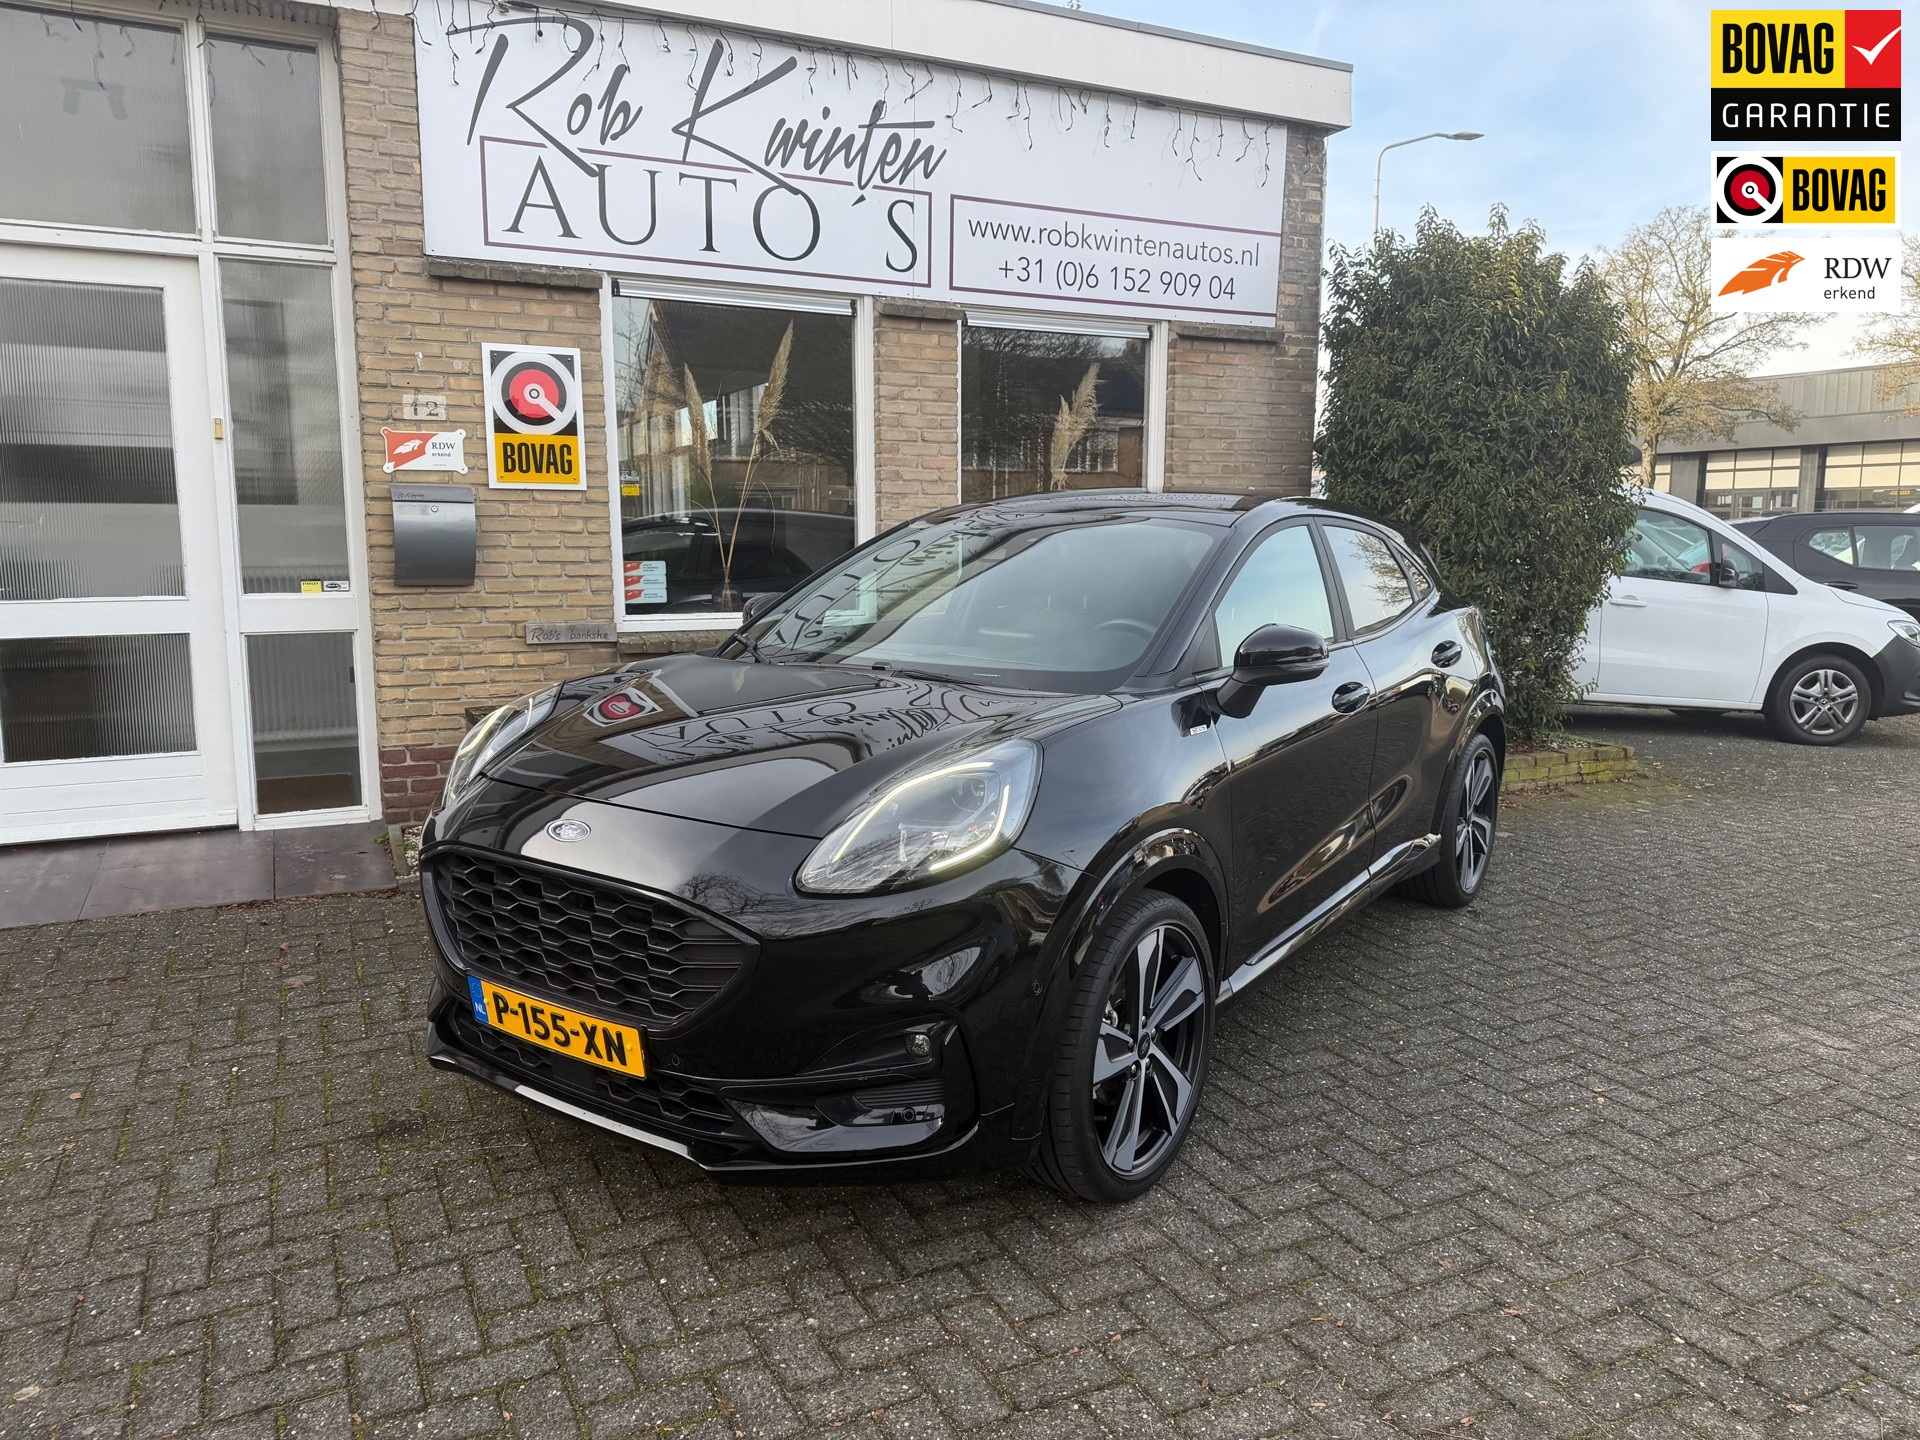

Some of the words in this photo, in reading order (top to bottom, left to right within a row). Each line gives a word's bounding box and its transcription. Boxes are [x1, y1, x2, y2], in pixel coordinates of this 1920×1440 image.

[447, 17, 643, 178] Rob
[672, 38, 947, 191] Kwinten
[501, 155, 918, 274] AUTO'S
[967, 217, 1260, 267] www.robkwintenautos.nl
[998, 256, 1044, 284] +31
[1056, 260, 1100, 292] (0)6
[1110, 266, 1152, 293] 152
[1160, 270, 1201, 298] 909
[1208, 274, 1236, 300] 04
[410, 400, 439, 417] 12
[431, 441, 456, 450] RDW
[502, 442, 573, 475] BOVAG
[530, 627, 561, 643] Rob's
[474, 1002, 487, 1015] NL
[491, 991, 628, 1067] P-155-XN
